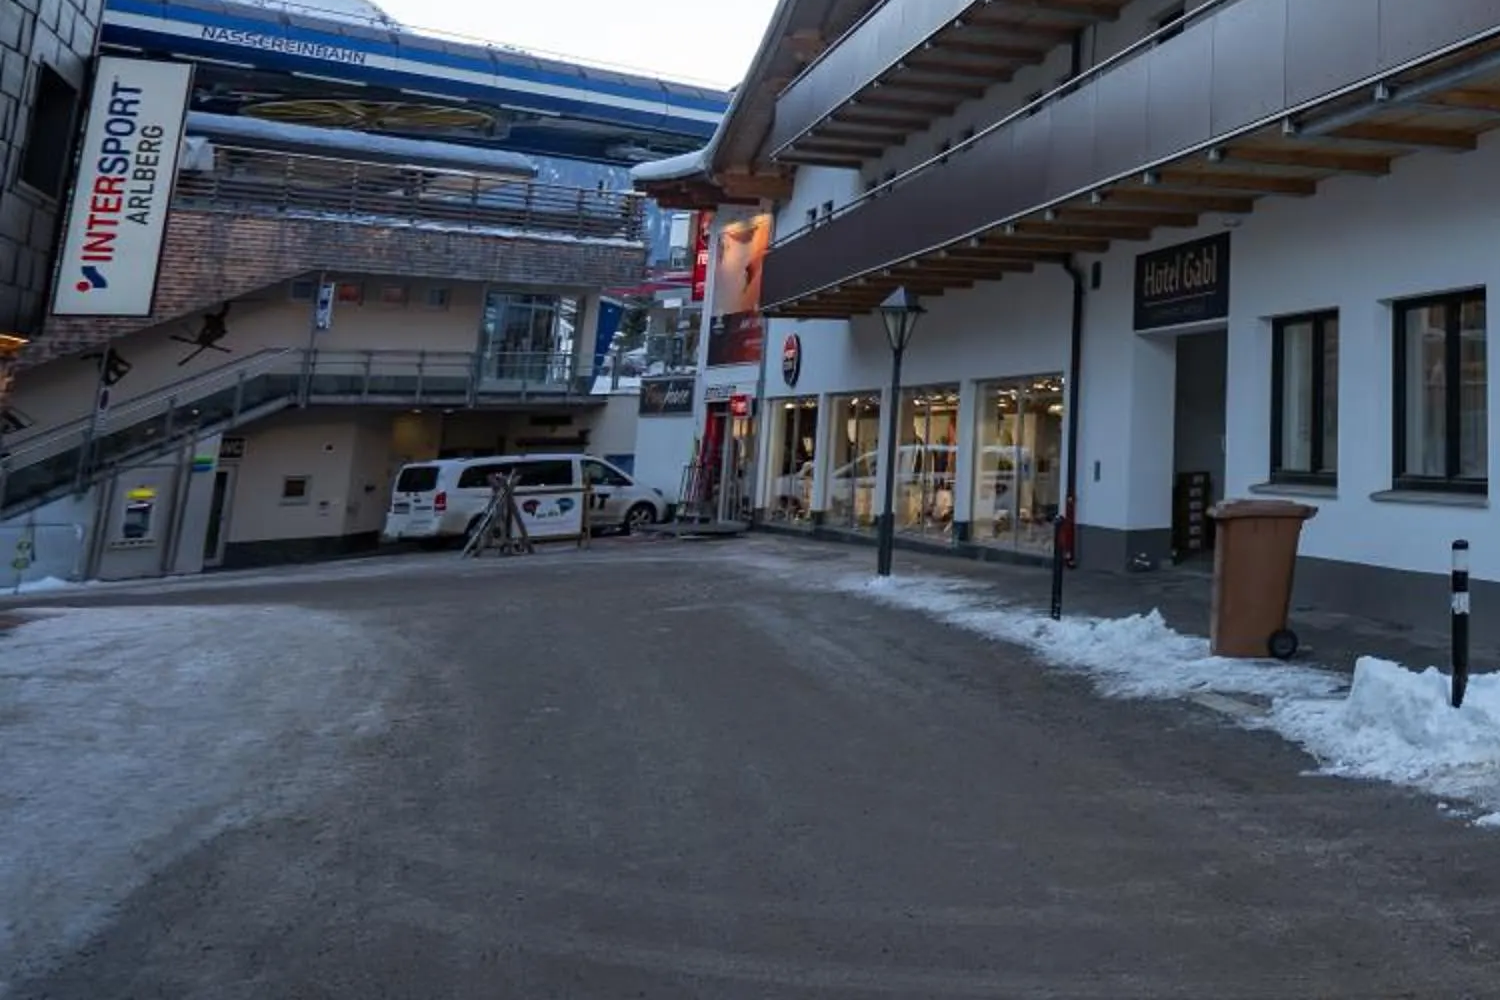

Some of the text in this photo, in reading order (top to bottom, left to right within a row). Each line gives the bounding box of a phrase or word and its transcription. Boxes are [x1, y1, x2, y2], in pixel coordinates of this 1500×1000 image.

[81, 81, 143, 262] INTERSPORT
[125, 124, 164, 226] ARLBERG
[1143, 243, 1217, 297] Hotel Gabl
